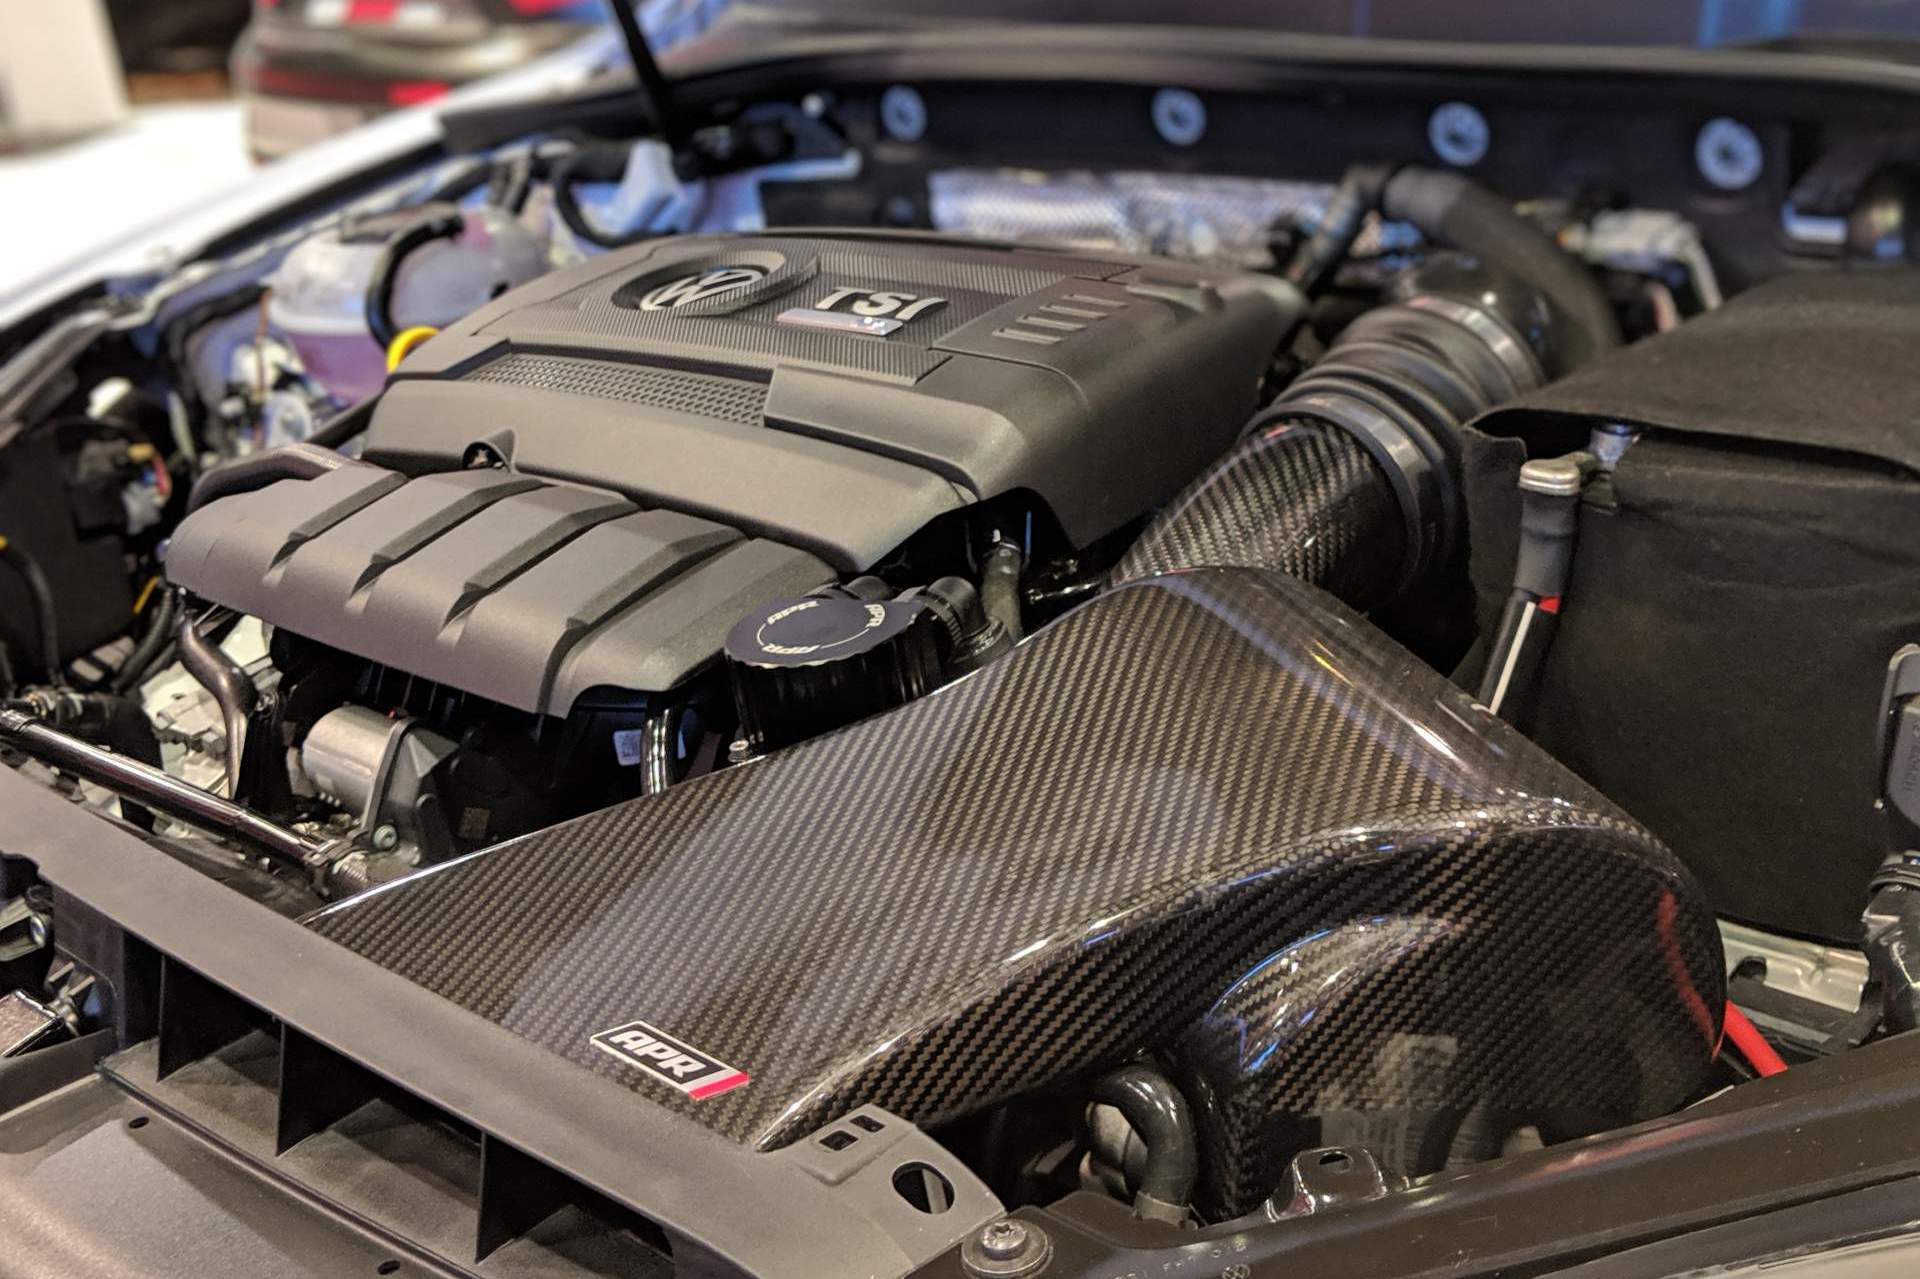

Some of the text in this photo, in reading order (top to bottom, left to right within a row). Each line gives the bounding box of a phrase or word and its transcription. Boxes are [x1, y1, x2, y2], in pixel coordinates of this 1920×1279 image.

[814, 286, 948, 321] TSI
[864, 603, 886, 628] APR
[761, 642, 821, 655] APR
[609, 1030, 707, 1079] APR
